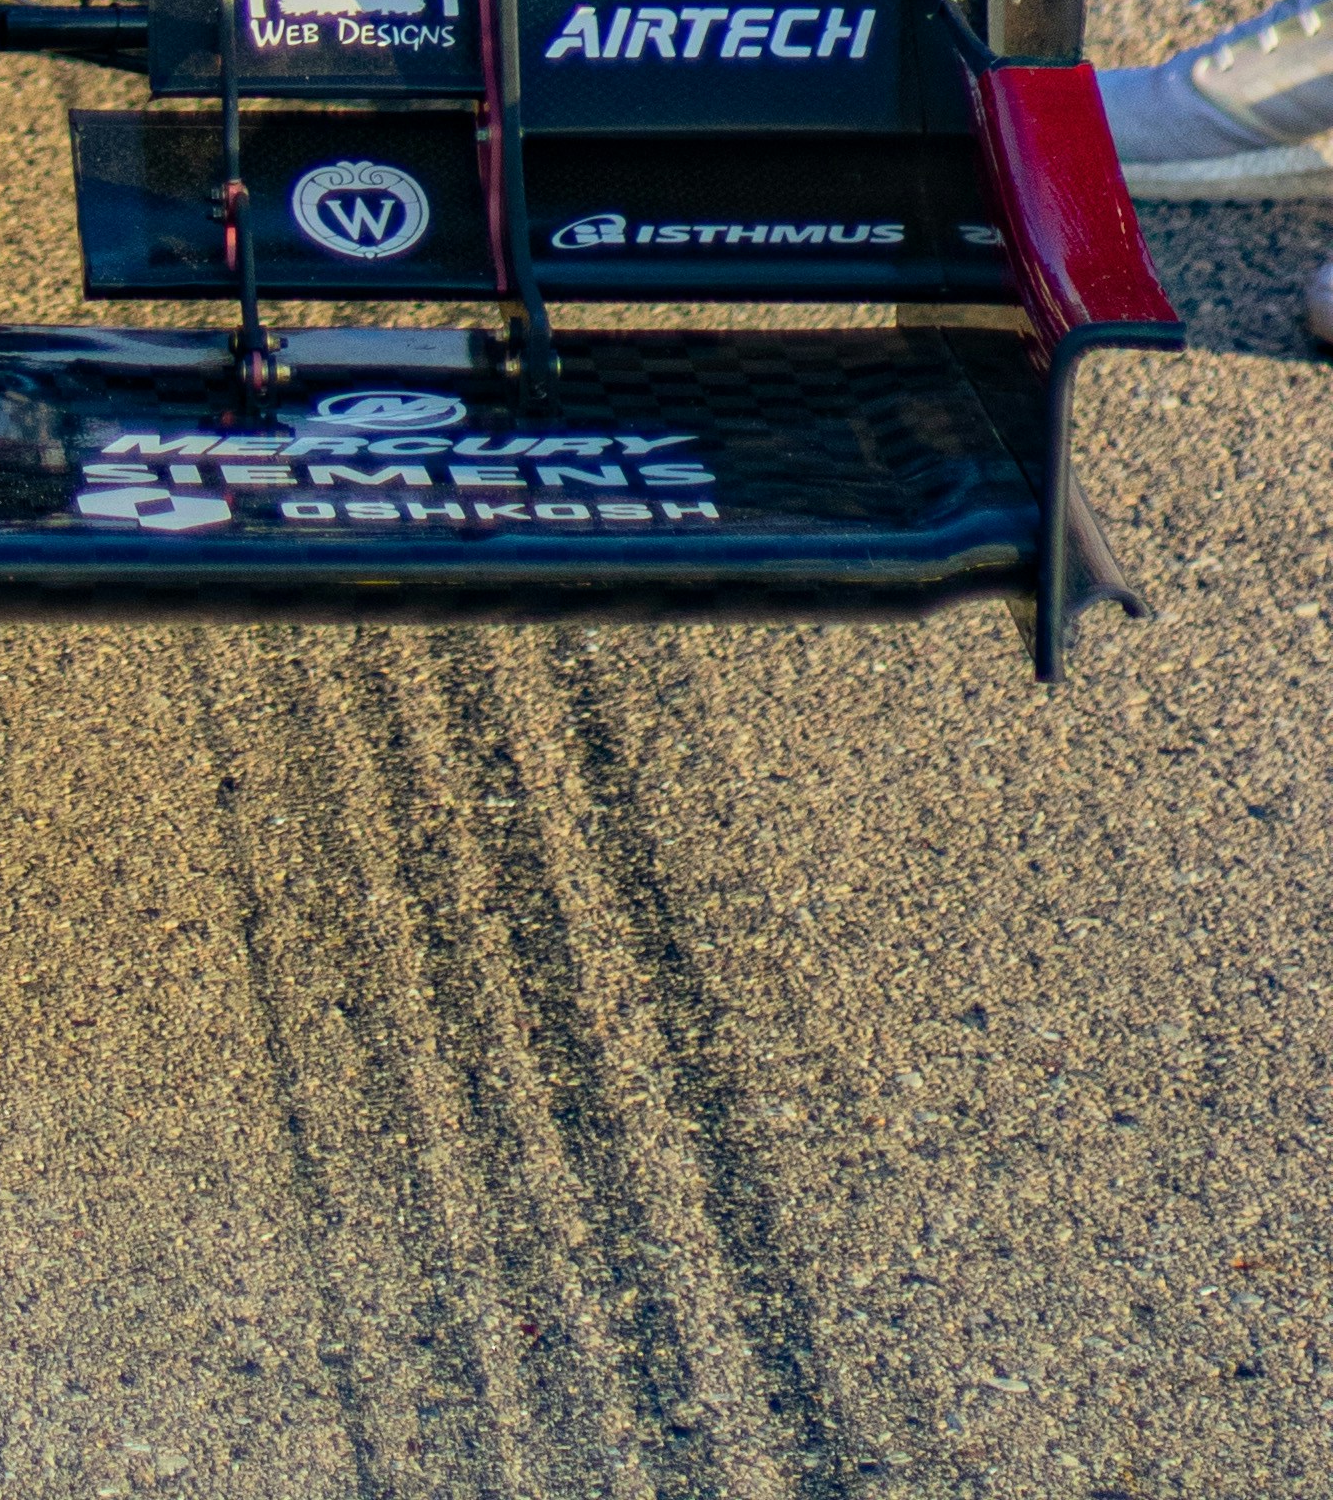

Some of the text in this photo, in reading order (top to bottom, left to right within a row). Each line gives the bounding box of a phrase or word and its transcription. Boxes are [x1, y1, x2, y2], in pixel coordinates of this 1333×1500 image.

[544, 6, 877, 59] AIRTECH
[324, 196, 396, 241] W
[635, 224, 906, 244] ISTHMUS
[100, 435, 701, 457] MERCURY
[81, 462, 718, 487] SIEMENS
[281, 501, 721, 521] OSHKOSH
